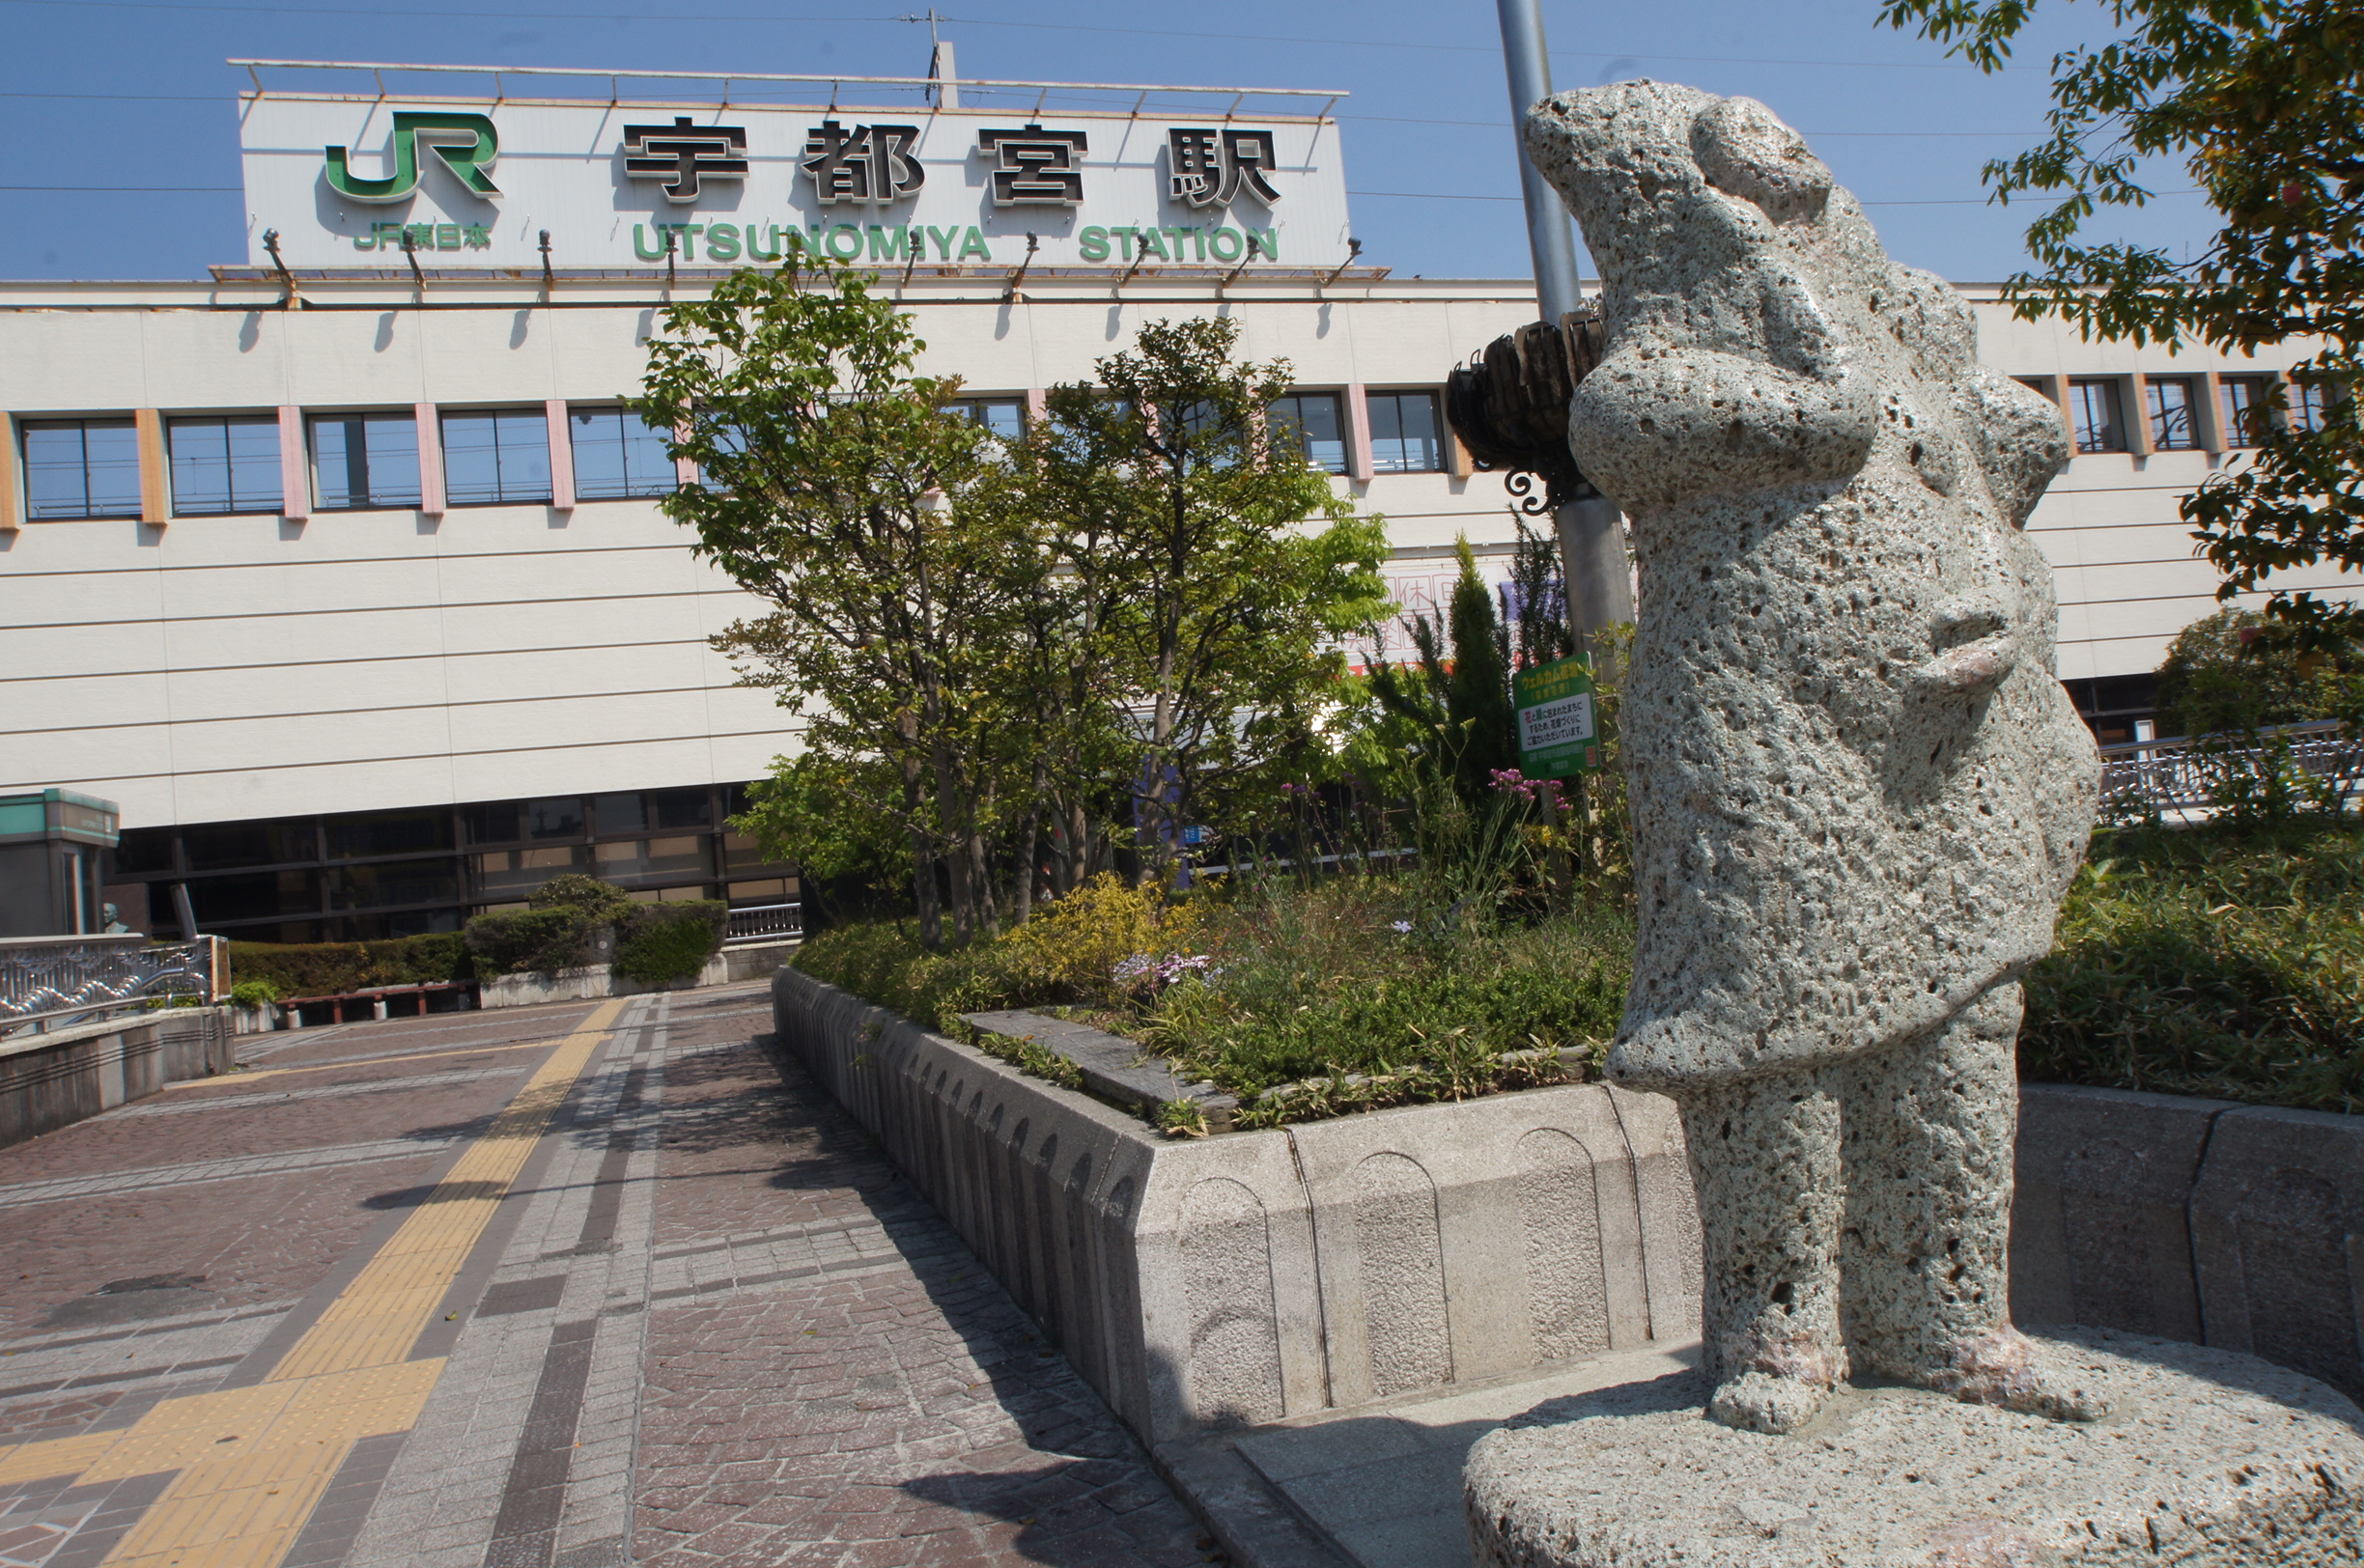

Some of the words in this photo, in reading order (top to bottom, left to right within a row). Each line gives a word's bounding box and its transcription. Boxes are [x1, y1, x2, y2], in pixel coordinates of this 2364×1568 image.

[325, 112, 504, 204] JR
[623, 117, 1282, 209] 宇都宮駅
[353, 222, 492, 250] JR東日本
[633, 223, 992, 261] UTSUNOMIYA
[1080, 225, 1279, 261] STATION
